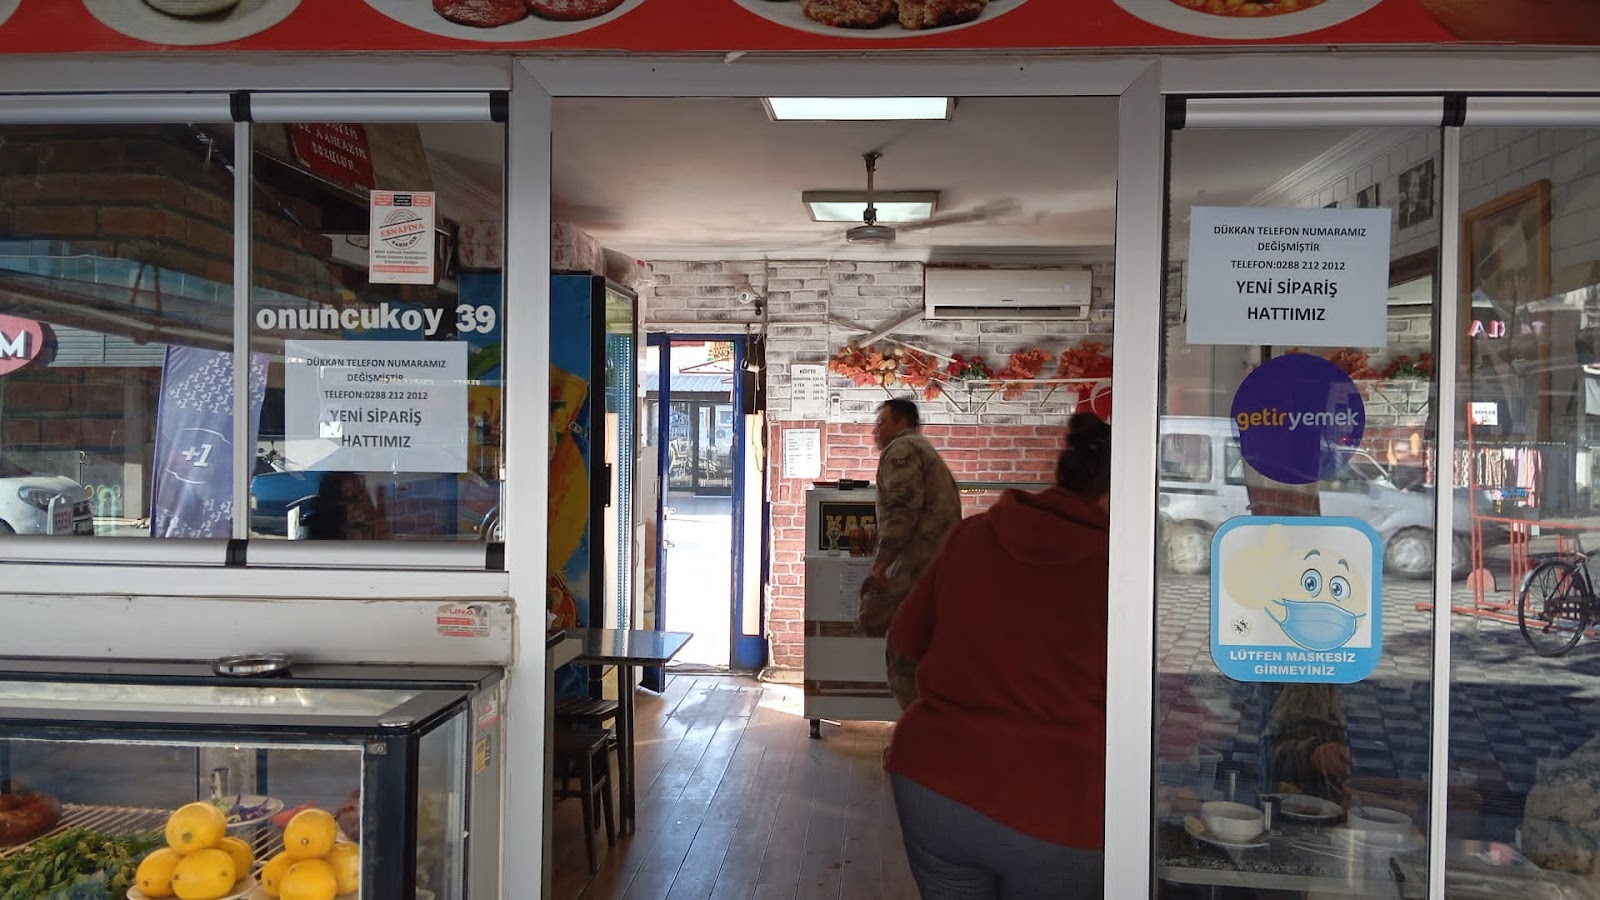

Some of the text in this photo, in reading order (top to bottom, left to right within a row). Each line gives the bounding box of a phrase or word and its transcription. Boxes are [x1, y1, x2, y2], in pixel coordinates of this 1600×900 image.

[1213, 224, 1367, 237] DÜKKAN TELEFON NUMARAMIZ
[1257, 240, 1320, 254] DEĞİŞMİŞTİR
[1231, 260, 1346, 271] TELEFON:0288 212 2012
[1236, 278, 1338, 298] YENİ SİPARİŞ
[256, 303, 496, 336] onuncukoy 39
[1247, 306, 1326, 321] HATTIMIZ
[306, 358, 446, 369] DÜKKAN TELEFON NUMARAMIZ
[324, 390, 428, 400] TELEFON:0288 212 2012
[330, 407, 422, 426] YENİ SİPARİŞ
[1236, 407, 1360, 431] getiryemek
[341, 434, 411, 448] HATTIMIZ
[181, 443, 214, 467] +1
[1229, 649, 1356, 663] LÜTFEN MASKESİZ
[1254, 662, 1335, 676] GİRMEYİNİZ
